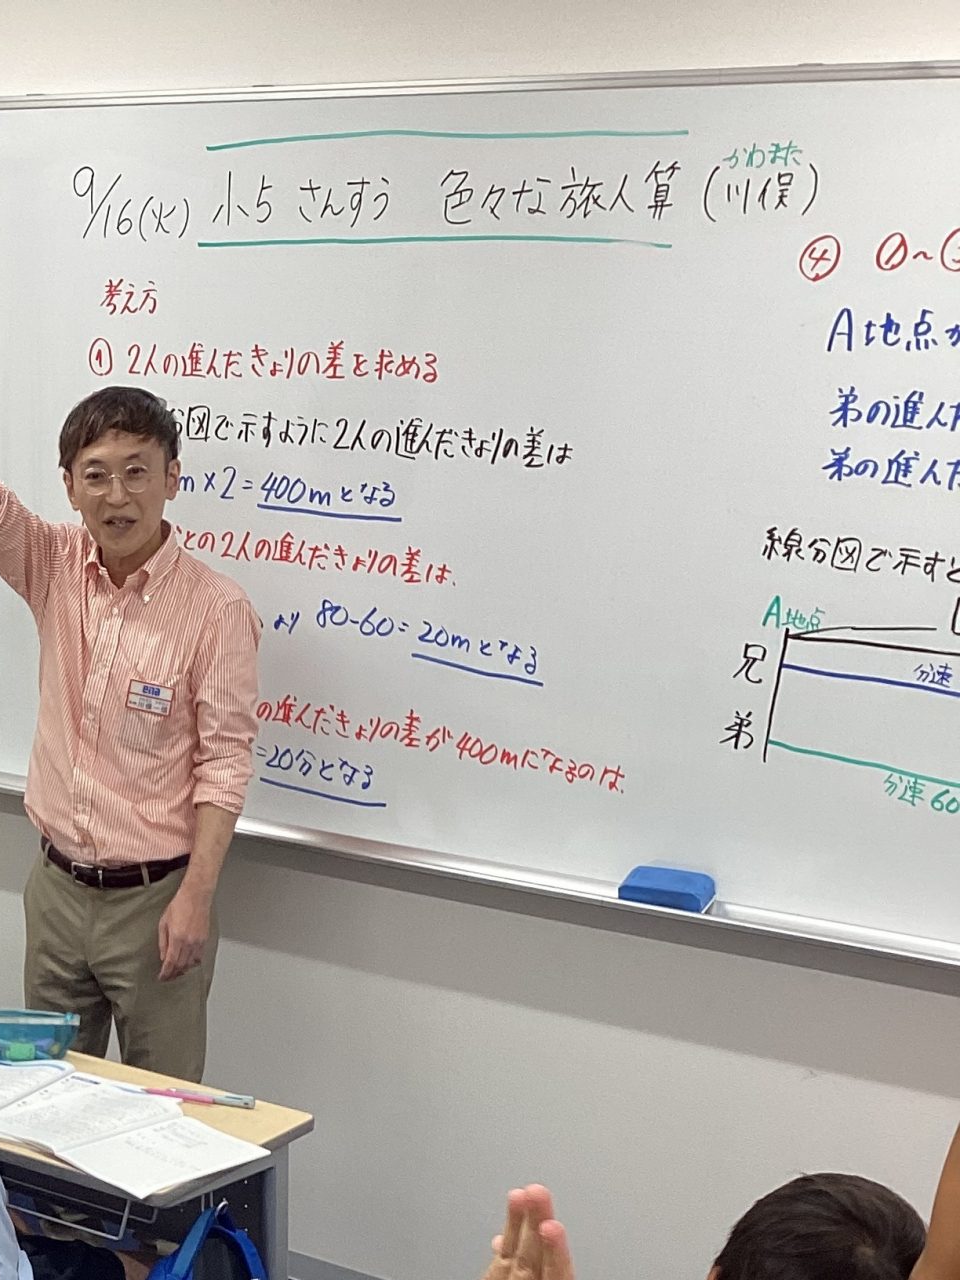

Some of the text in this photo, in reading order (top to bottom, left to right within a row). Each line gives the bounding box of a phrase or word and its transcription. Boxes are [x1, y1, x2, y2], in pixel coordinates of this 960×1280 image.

[299, 176, 391, 228] さんすう
[441, 160, 681, 225] 色々な旅人算
[100, 278, 158, 315] 考え方
[762, 595, 825, 633] A地点
[732, 643, 768, 684] 兄
[720, 711, 754, 749] 弟
